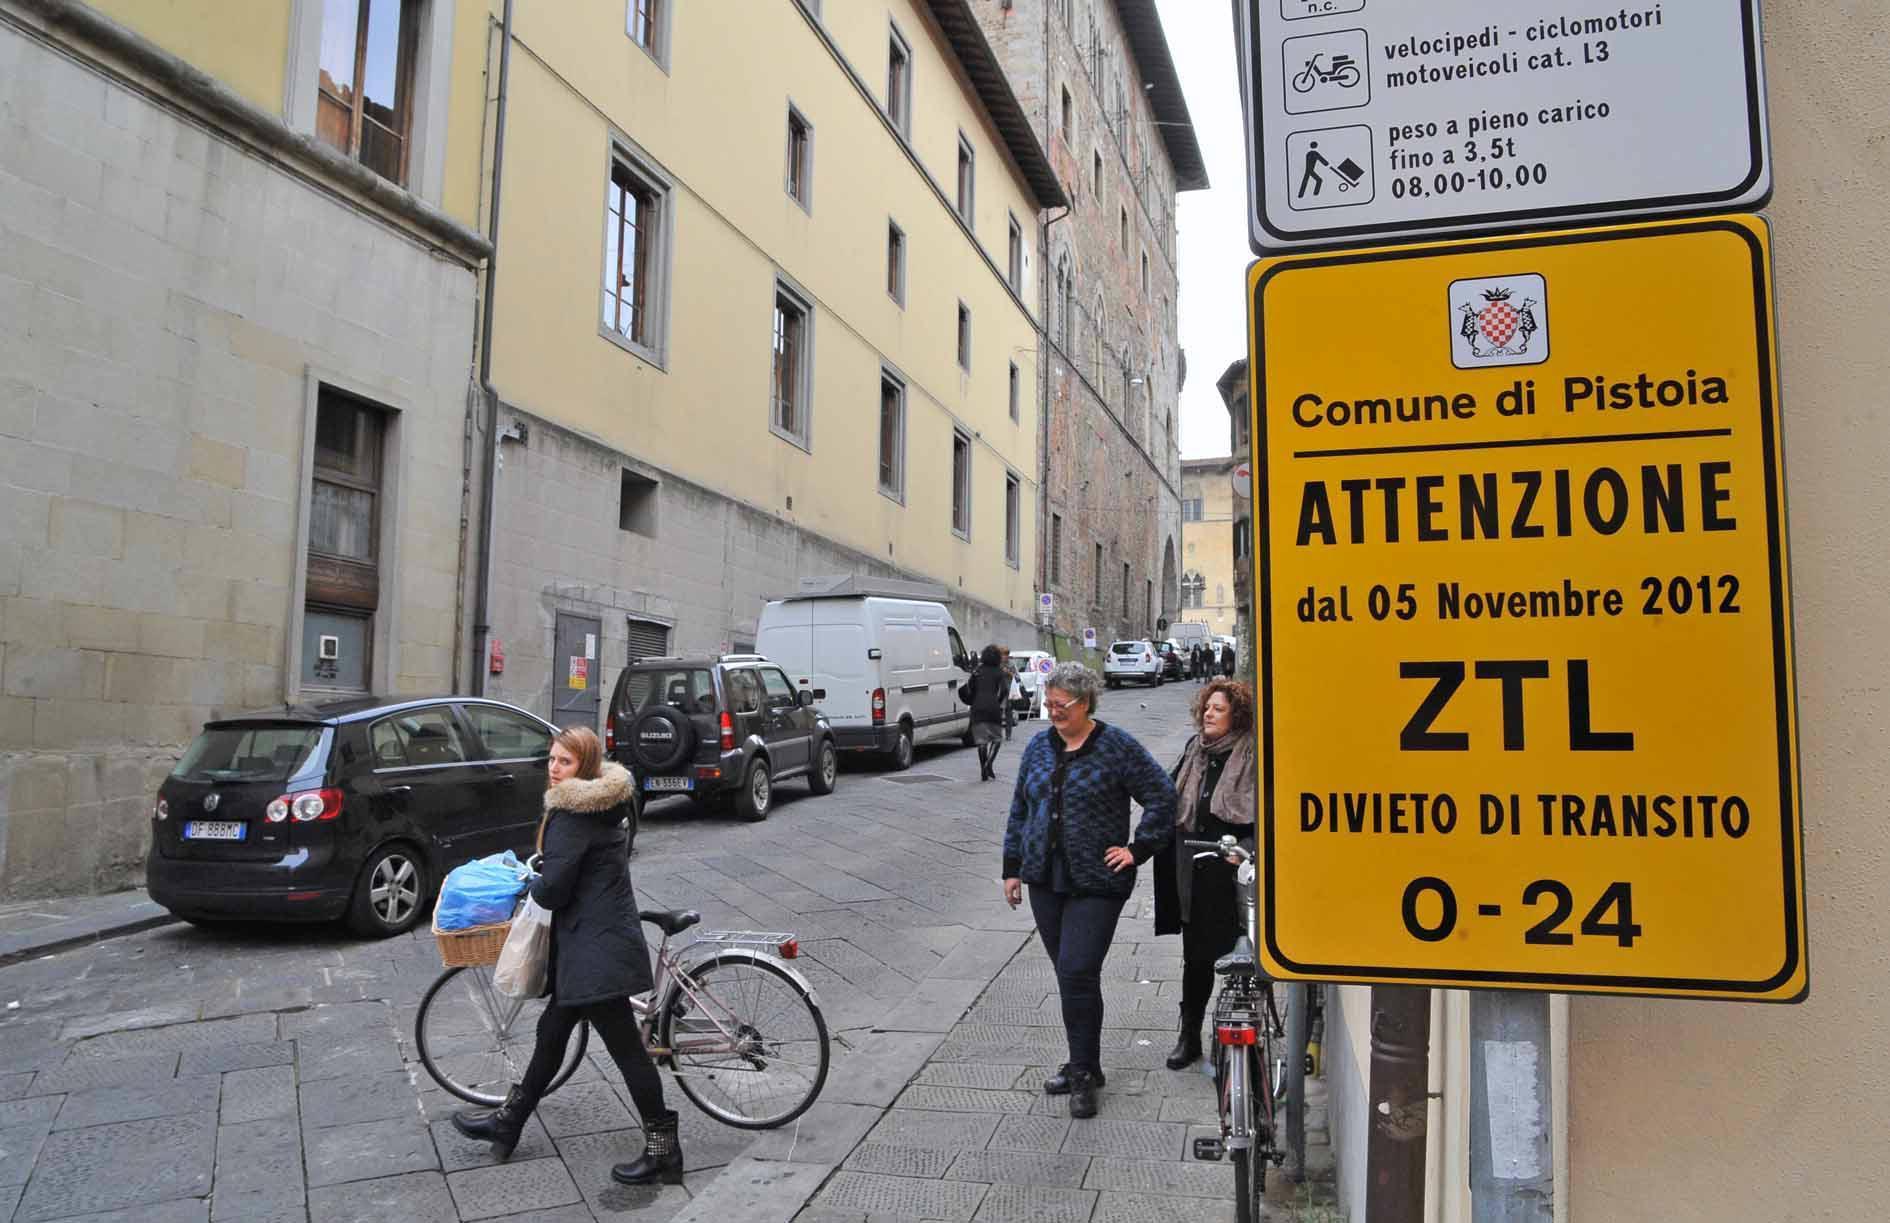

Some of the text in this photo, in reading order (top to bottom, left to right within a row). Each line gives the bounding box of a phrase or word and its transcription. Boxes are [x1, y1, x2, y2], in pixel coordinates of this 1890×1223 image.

[1384, 25, 1499, 60] velocipedi
[1526, 3, 1662, 42] ciclomotori
[1386, 41, 1610, 88] motoveicoli cat. L3
[1389, 102, 1610, 147] peso a pieno carico
[1389, 137, 1516, 170] fino a 3,5t
[1391, 163, 1547, 199] 08,00-10,00
[1292, 369, 1732, 428] Comune di Pistoia
[1295, 461, 1737, 546] ATTENZIONE
[1297, 574, 1741, 623] dal 05 Novembre 2012
[1399, 659, 1635, 752] ZTL
[1300, 792, 1750, 840] DIVIETO DI TRANSITO
[1401, 876, 1642, 948] 0 - 24
